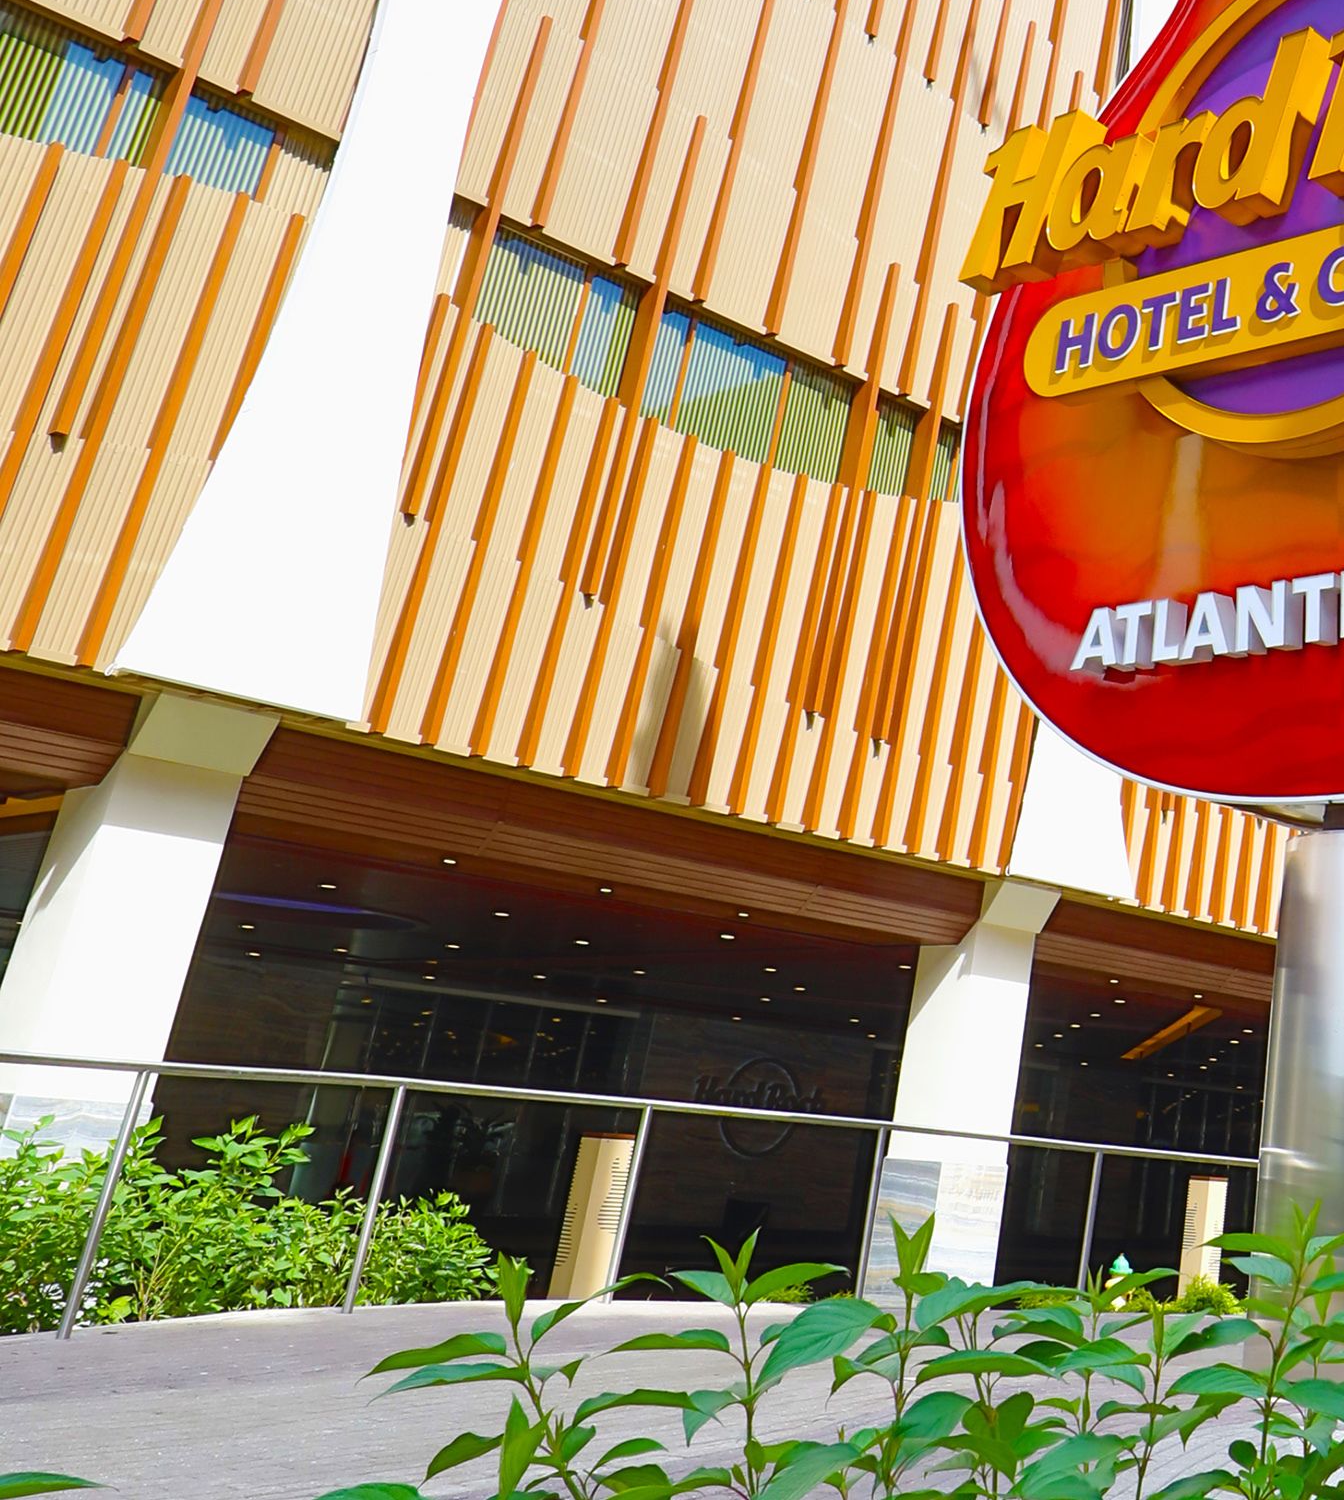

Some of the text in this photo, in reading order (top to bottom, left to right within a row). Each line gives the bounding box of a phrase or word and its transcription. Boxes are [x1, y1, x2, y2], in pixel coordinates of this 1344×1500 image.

[957, 26, 1335, 295] Hard
[1055, 277, 1241, 374] HOTEL
[1255, 262, 1299, 324] &
